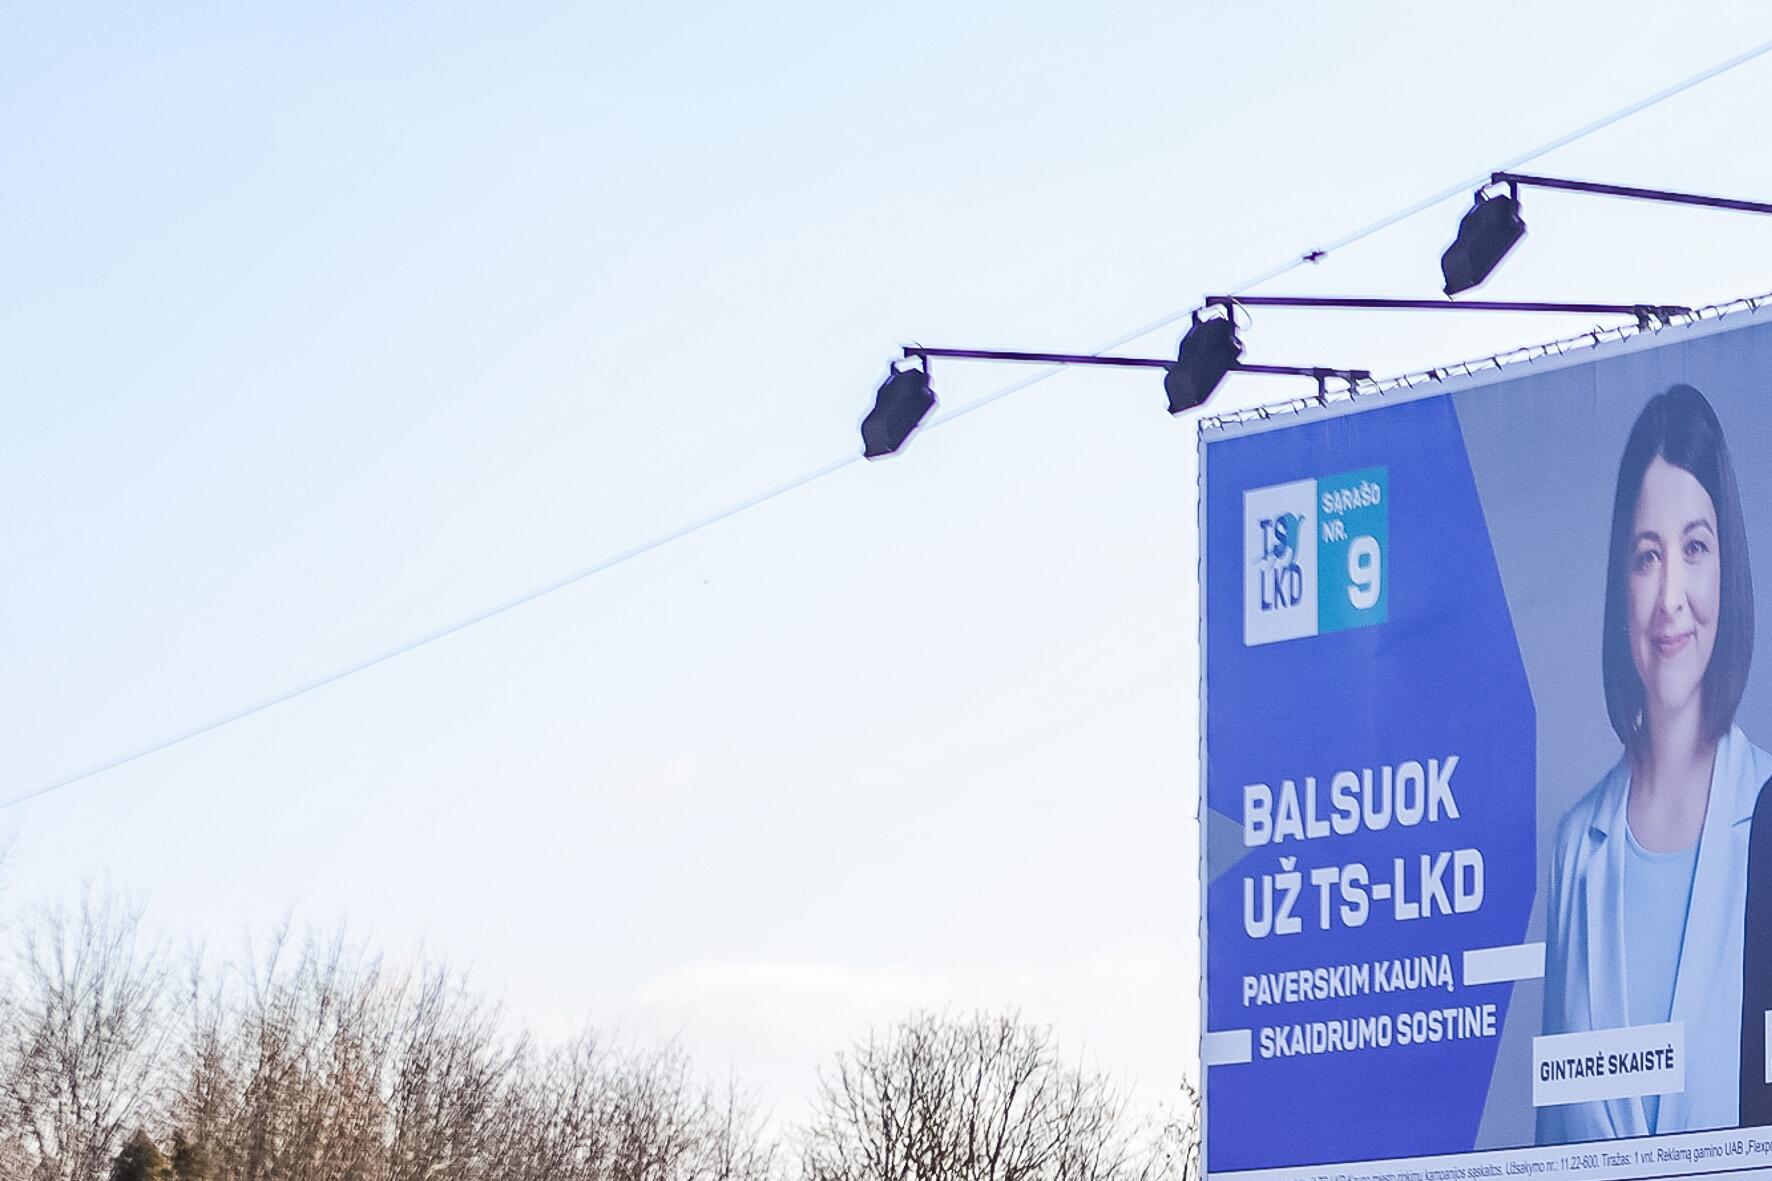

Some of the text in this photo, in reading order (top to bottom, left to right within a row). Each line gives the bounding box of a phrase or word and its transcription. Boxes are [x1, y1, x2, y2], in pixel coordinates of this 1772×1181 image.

[1321, 480, 1381, 516] SĄRAŠO
[1322, 520, 1348, 543] NR.
[1260, 563, 1304, 611] LKD
[1348, 535, 1382, 610] 9
[1243, 755, 1460, 848] BALSUOK
[1243, 848, 1484, 938] UŽ TS-LKD
[1243, 954, 1454, 1006] PAVERSKIM KAUNĄ
[1260, 1004, 1496, 1059] SKAIDRUMO SOSTINE
[1540, 1044, 1674, 1082] GINTARĖ SKAISTĖ
[1724, 1140, 1743, 1157] UAB
